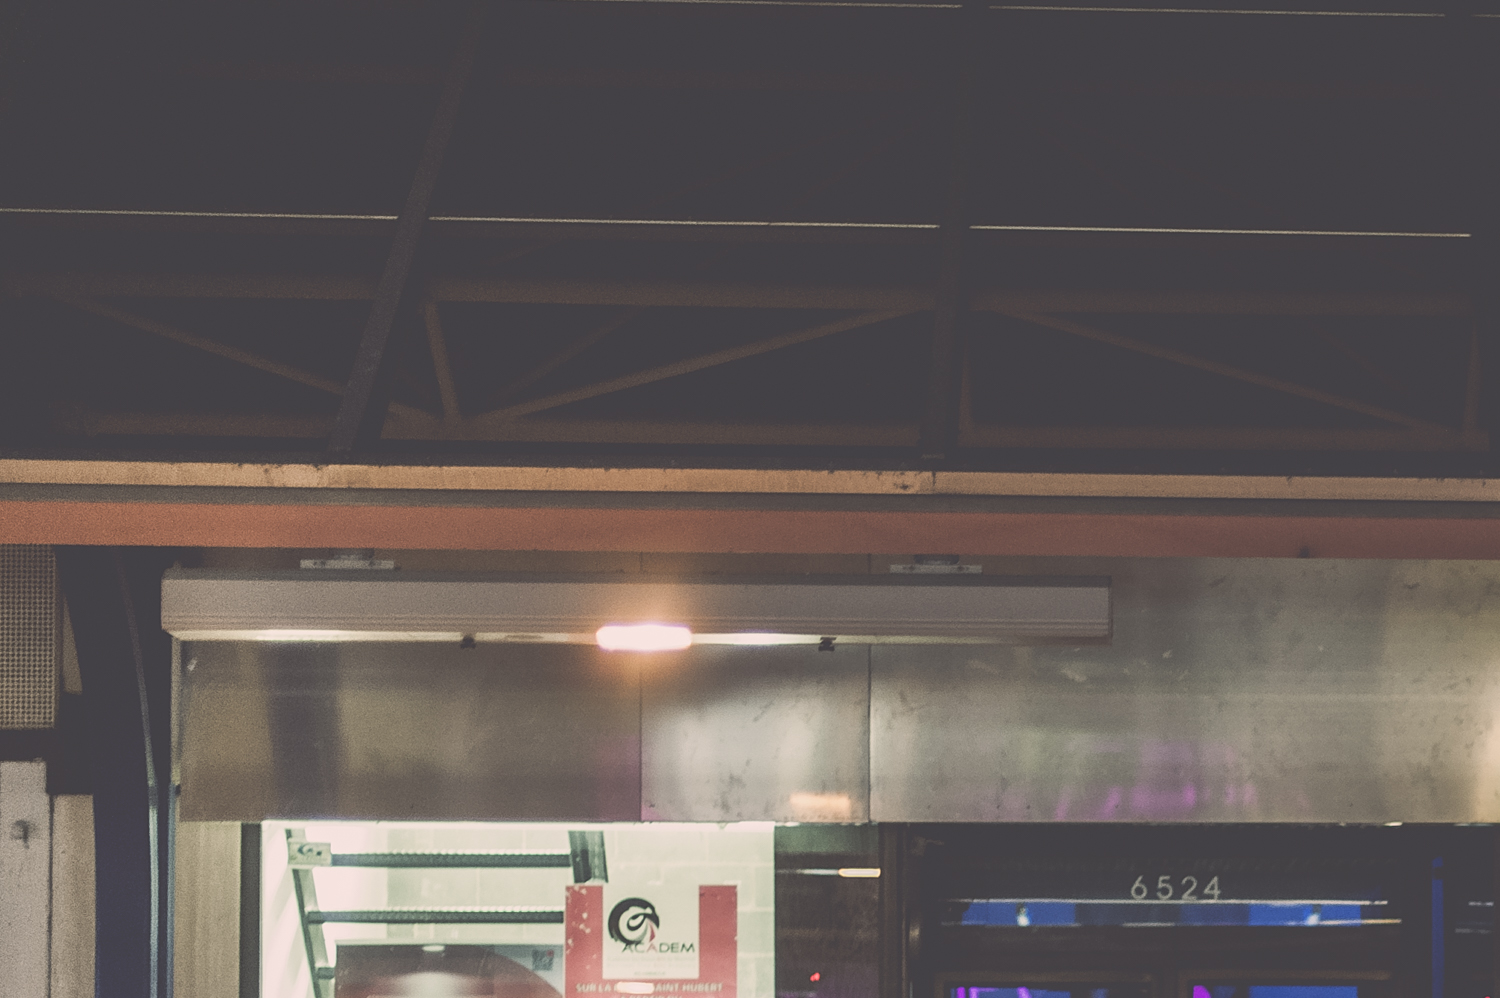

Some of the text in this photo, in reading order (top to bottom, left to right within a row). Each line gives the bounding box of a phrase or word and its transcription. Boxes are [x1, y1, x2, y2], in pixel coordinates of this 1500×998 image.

[1131, 876, 1221, 900] 6524
[622, 942, 695, 953] ACADEM
[654, 983, 679, 992] AINT
